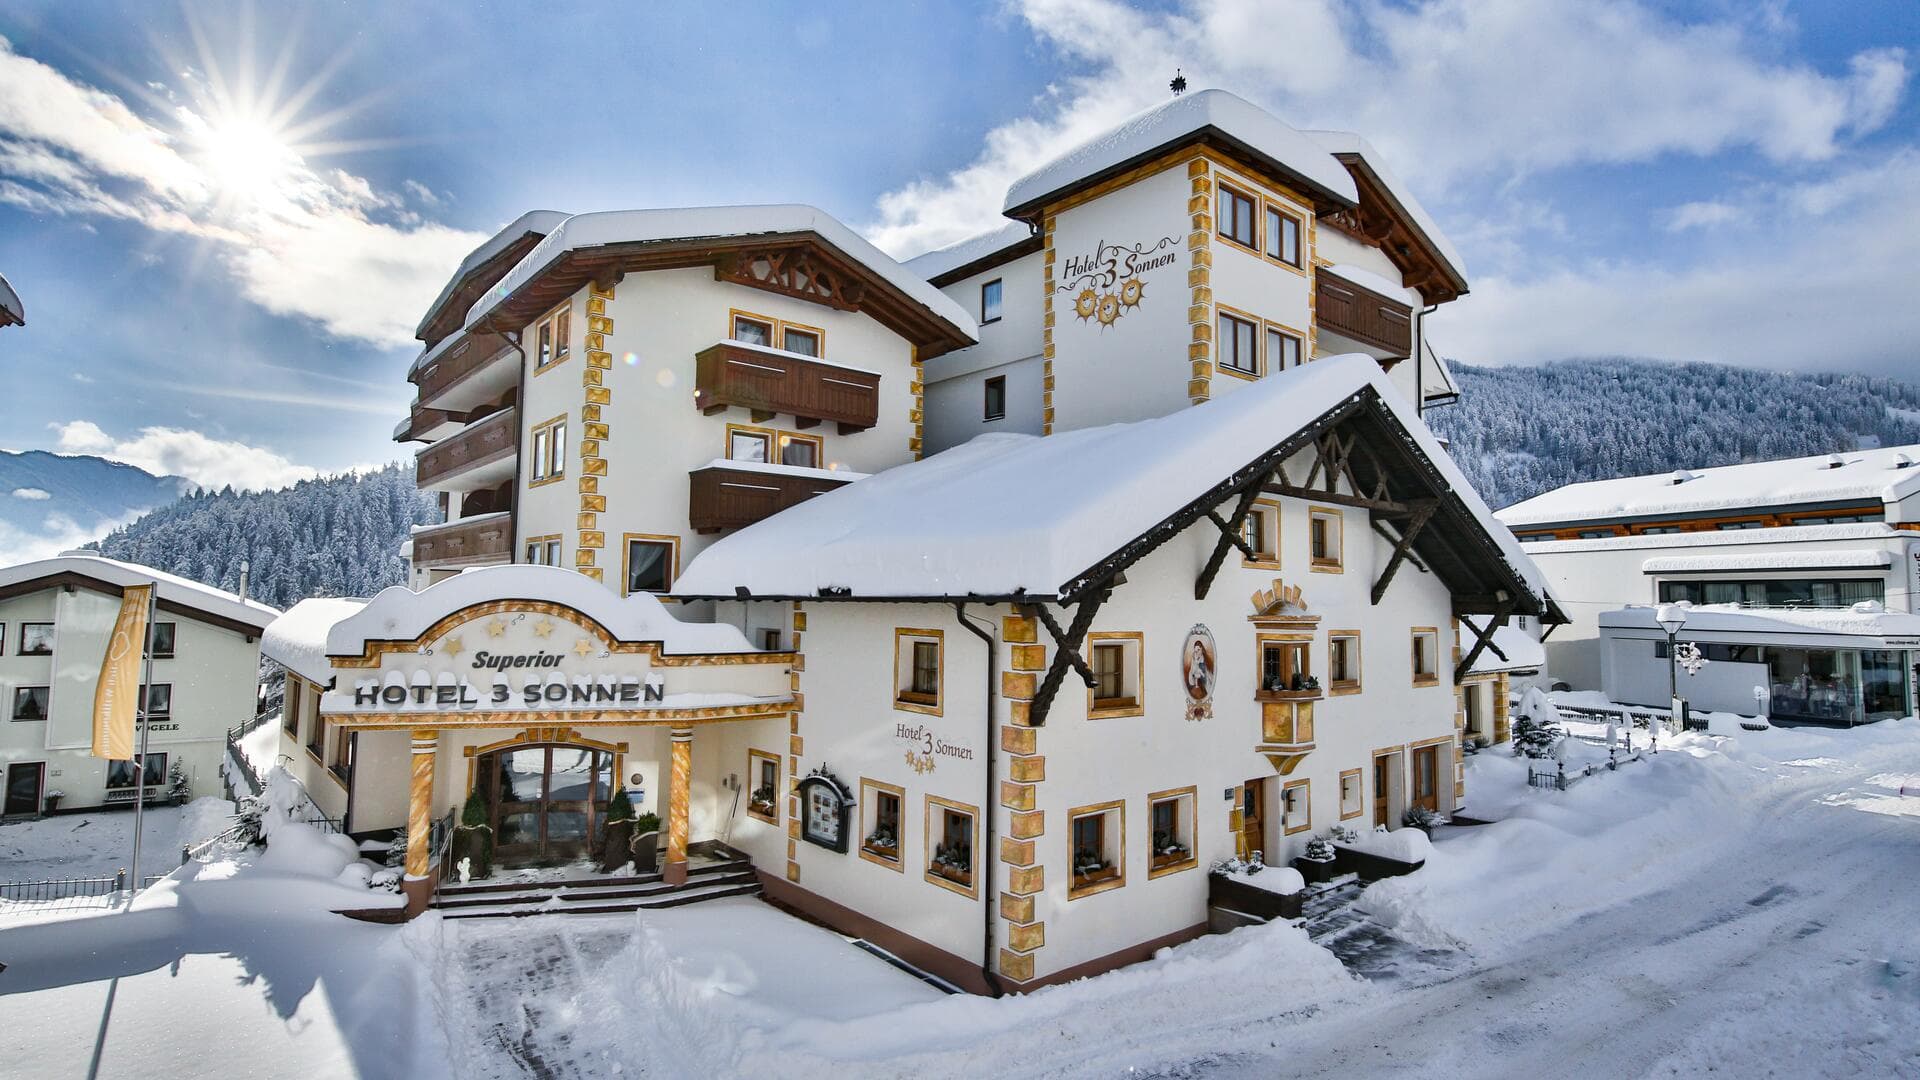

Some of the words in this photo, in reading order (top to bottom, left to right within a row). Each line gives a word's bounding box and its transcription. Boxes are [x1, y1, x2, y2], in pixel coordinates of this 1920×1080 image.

[1064, 240, 1104, 279] Hotel
[1120, 253, 1176, 279] Sonnen
[472, 650, 565, 672] Superior
[355, 684, 478, 705] HOTEL
[491, 684, 510, 703] 3
[524, 683, 664, 703] SONNEN
[136, 724, 180, 732] VGELE
[896, 723, 923, 741] Hotel
[922, 732, 933, 755] 3
[935, 739, 974, 760] Sonnen
